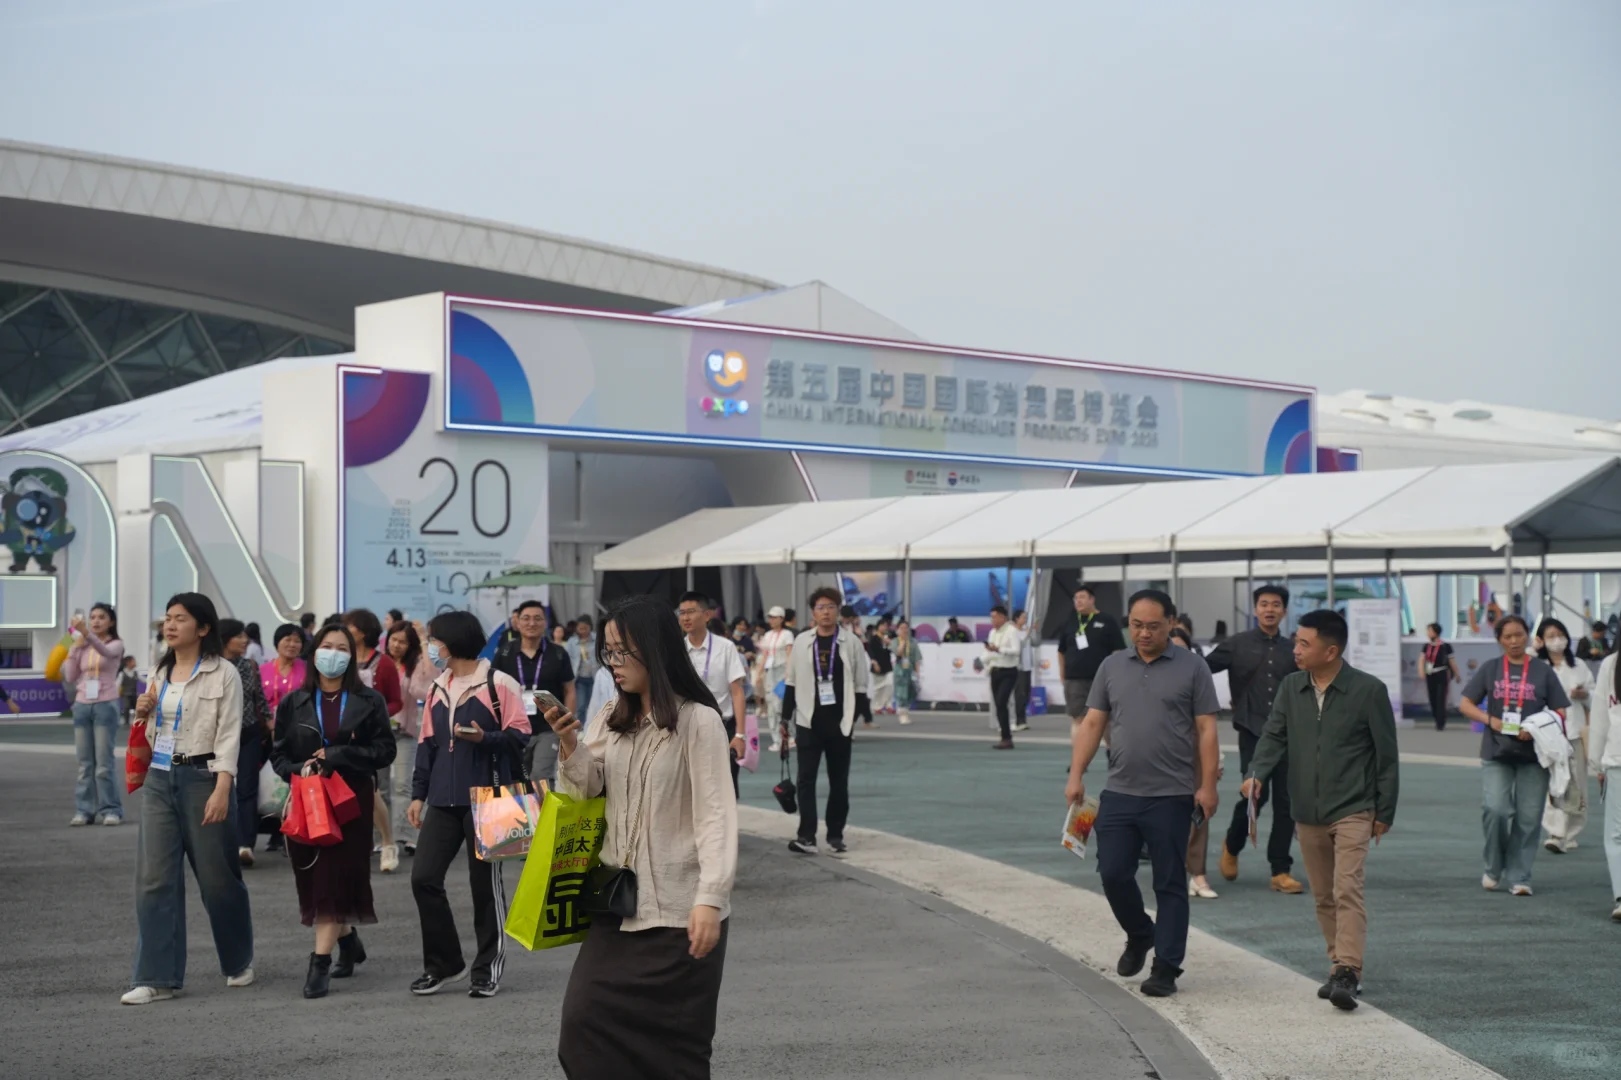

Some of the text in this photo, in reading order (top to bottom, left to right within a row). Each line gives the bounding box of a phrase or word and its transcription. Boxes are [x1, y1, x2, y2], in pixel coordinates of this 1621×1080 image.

[699, 396, 749, 418] expo
[765, 402, 813, 422] CHINA
[822, 405, 935, 431] INTERNATIONAL
[1023, 422, 1089, 443] PRODUCTS
[419, 456, 511, 539] 20
[386, 547, 426, 568] 4.13
